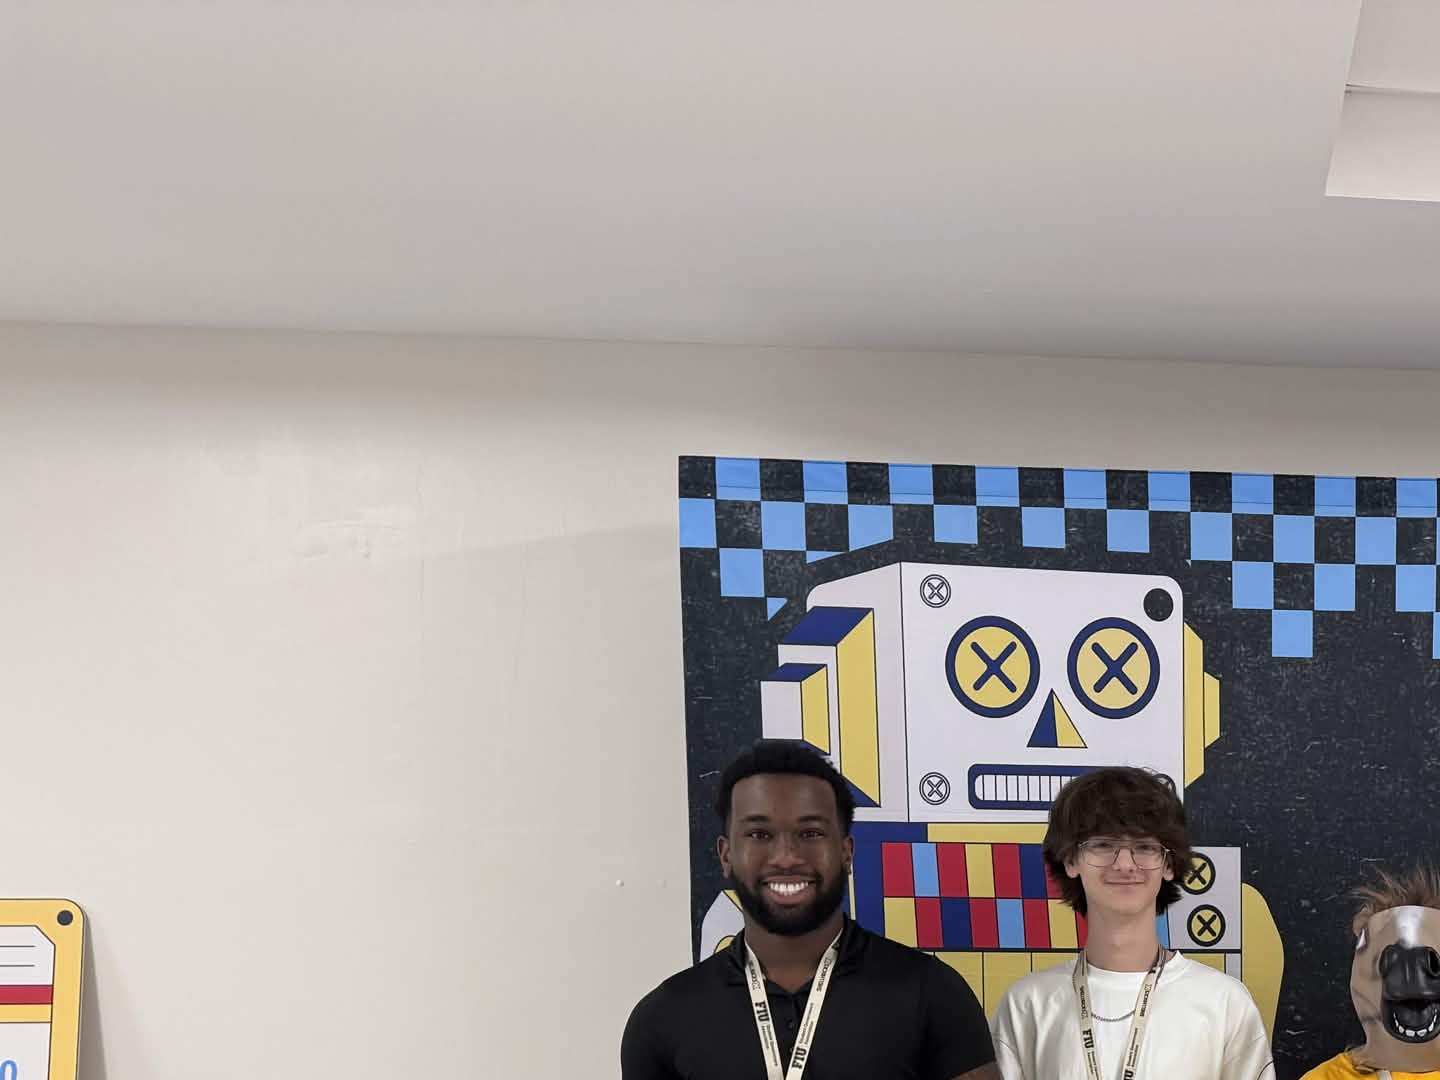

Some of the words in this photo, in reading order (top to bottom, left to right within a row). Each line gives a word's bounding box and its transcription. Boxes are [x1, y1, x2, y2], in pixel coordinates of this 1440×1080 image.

[755, 1000, 770, 1021] FIU
[1083, 1028, 1095, 1049] FIU
[792, 1047, 807, 1069] FIU
